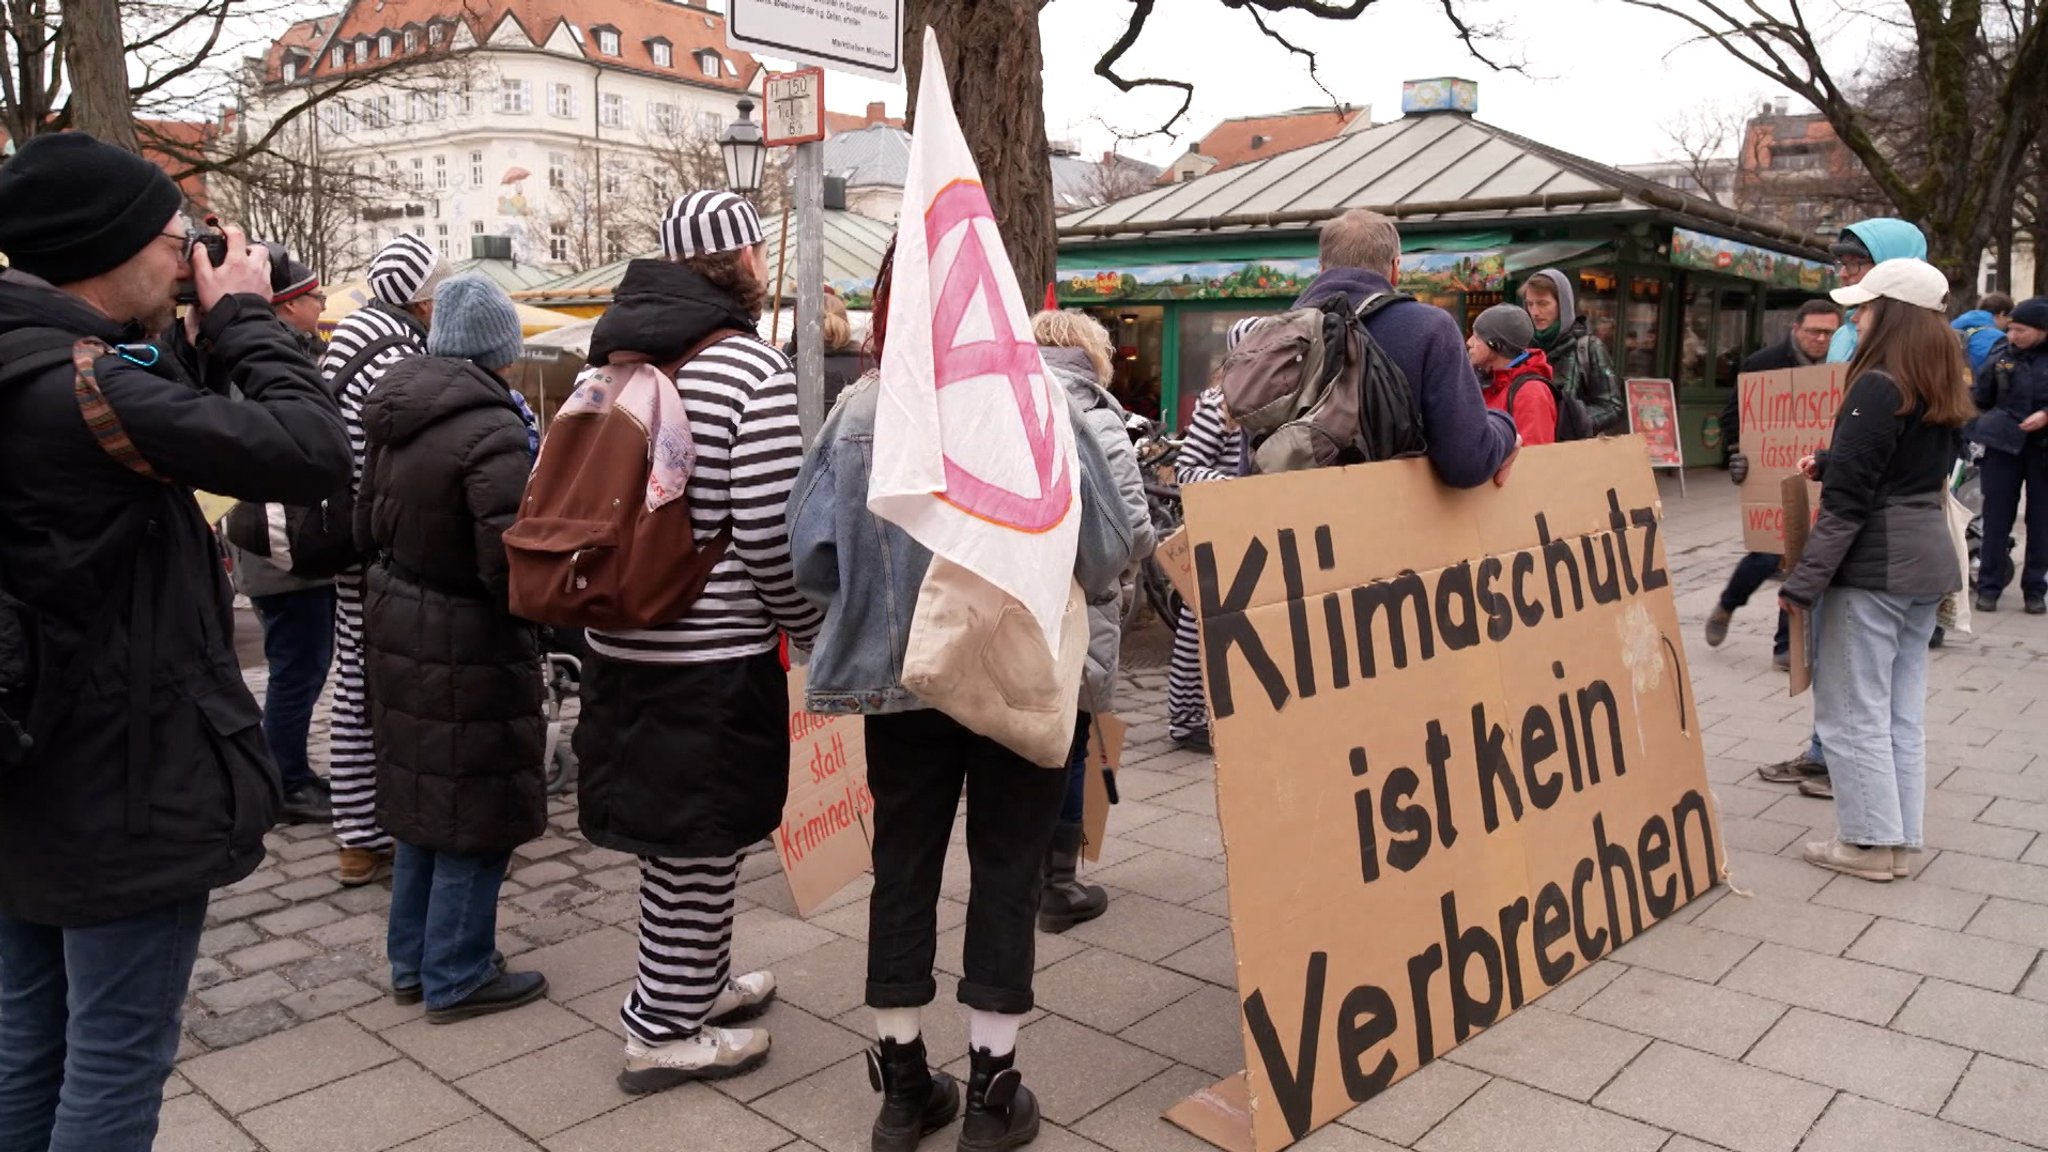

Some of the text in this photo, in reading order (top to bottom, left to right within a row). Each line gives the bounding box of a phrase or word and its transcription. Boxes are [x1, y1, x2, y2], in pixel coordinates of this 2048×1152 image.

[1741, 369, 1842, 434] Klimasch
[1747, 508, 1786, 541] weg
[1194, 488, 1669, 720] Klimaschutz
[809, 731, 847, 785] statt
[1348, 660, 1626, 884] ist kein
[780, 775, 873, 872] Kriminalisi
[1242, 788, 1717, 1143] Verbrechen
